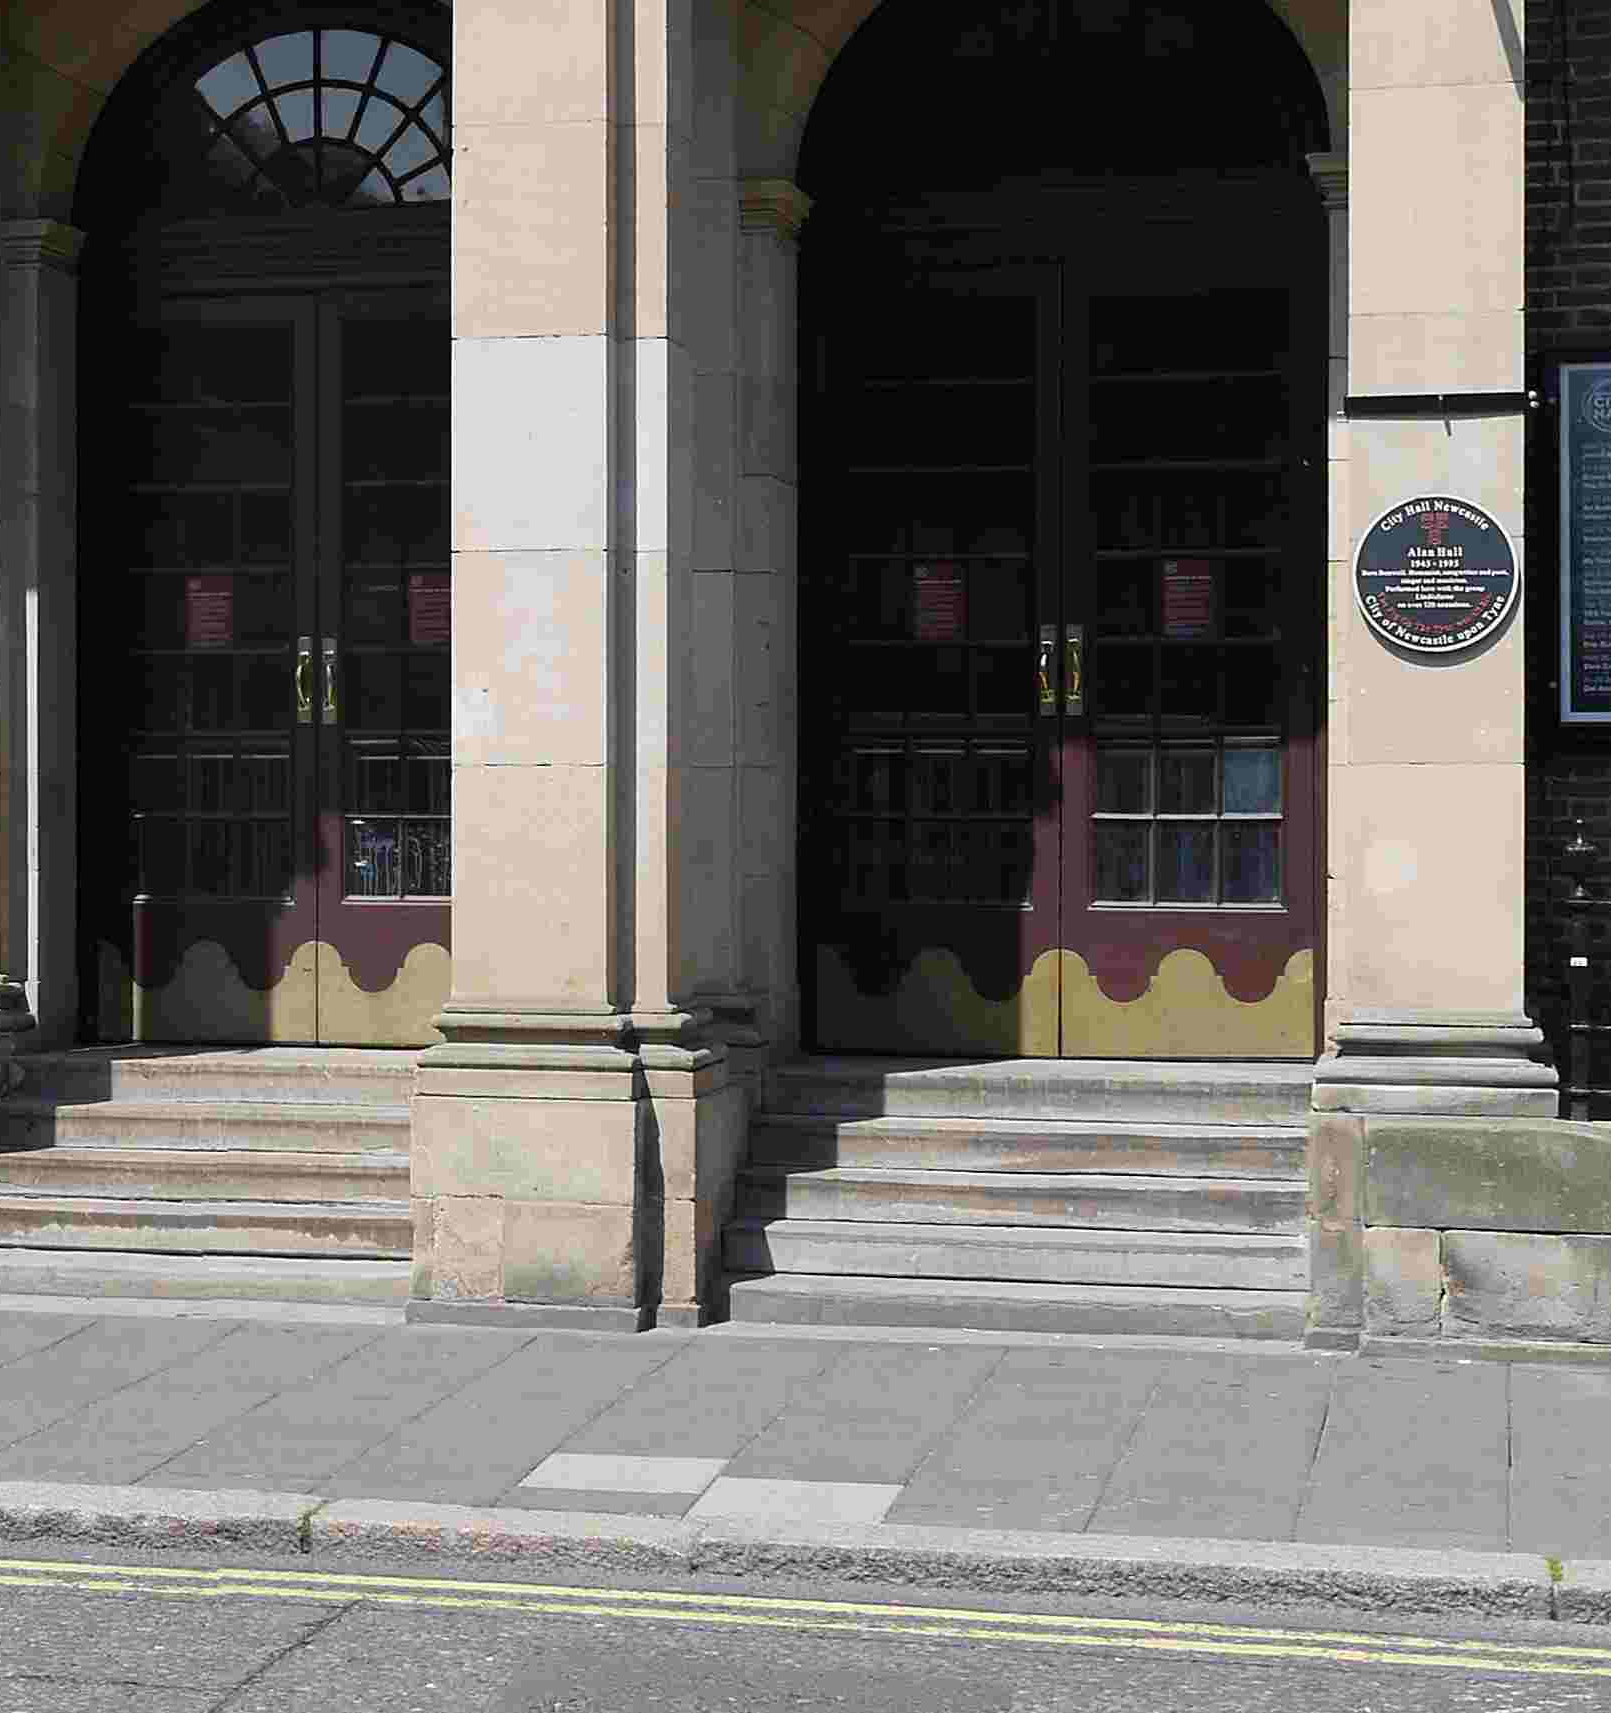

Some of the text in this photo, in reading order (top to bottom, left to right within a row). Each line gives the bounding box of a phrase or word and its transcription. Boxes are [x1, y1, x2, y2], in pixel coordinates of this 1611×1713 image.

[1380, 500, 1490, 531] City Hall Newcastle
[1407, 546, 1463, 557] Alan Hull
[1365, 594, 1384, 622] City
[1381, 618, 1393, 631] of
[1395, 627, 1454, 645] Newcastle
[1456, 621, 1484, 640] upon
[1482, 595, 1506, 621] Tyne
